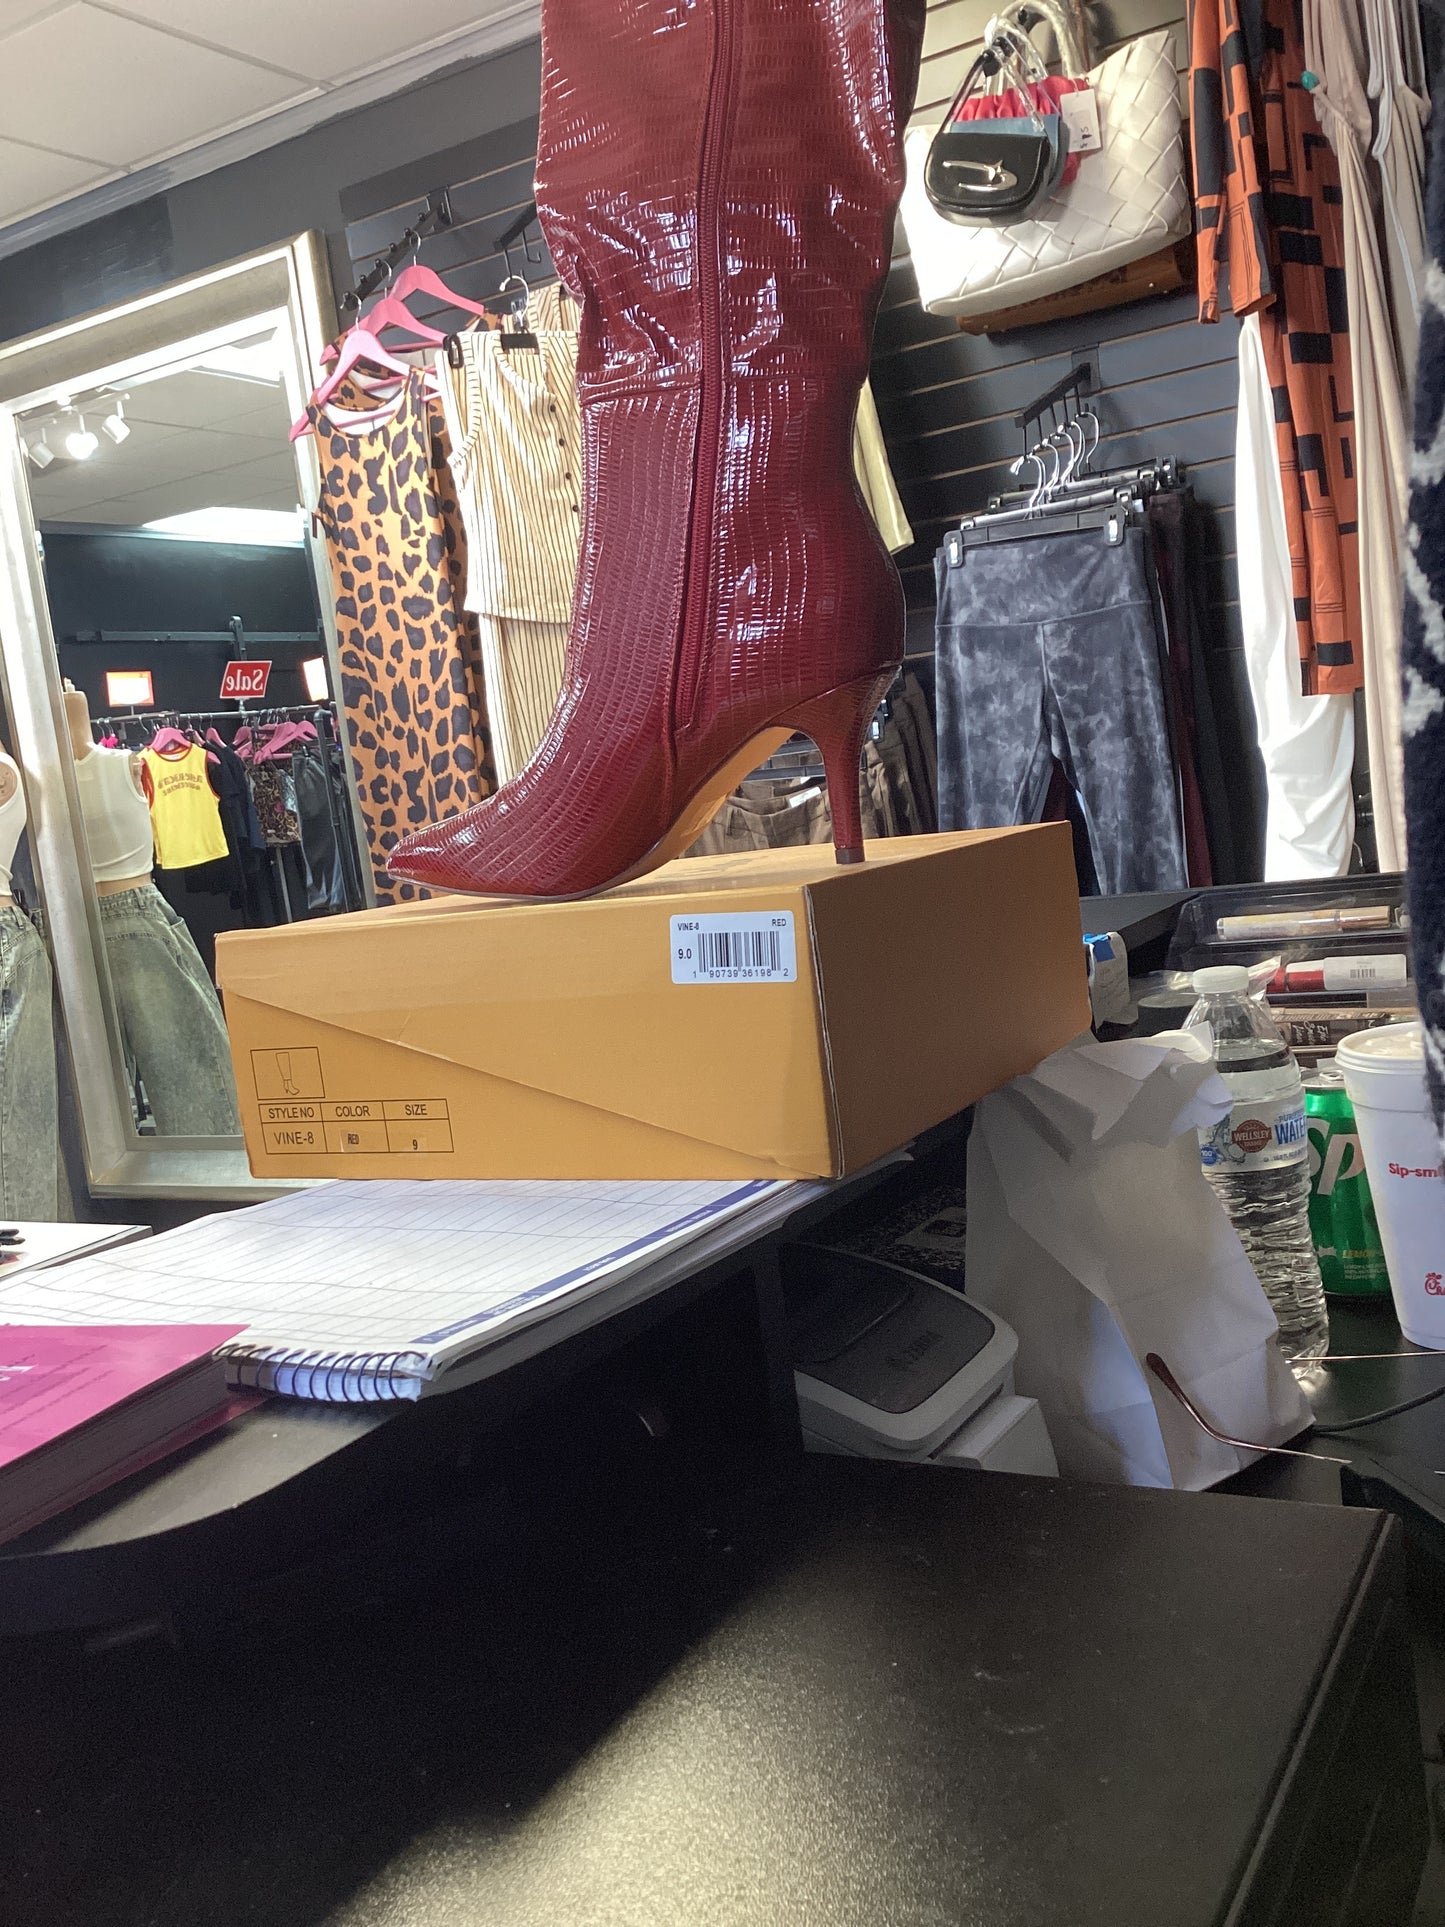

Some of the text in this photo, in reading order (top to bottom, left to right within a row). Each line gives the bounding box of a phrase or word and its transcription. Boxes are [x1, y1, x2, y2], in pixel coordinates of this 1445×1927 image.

[677, 918, 787, 931] VINE-8 RED
[678, 948, 692, 959] 9.0
[709, 969, 739, 978] 90739
[742, 968, 772, 978] 36198
[783, 968, 789, 977] 2
[268, 1104, 428, 1119] STYLE NO COLOR SIZE
[274, 1131, 418, 1150] VINE-8 RED 9
[1233, 1130, 1270, 1142] WELLSLEY
